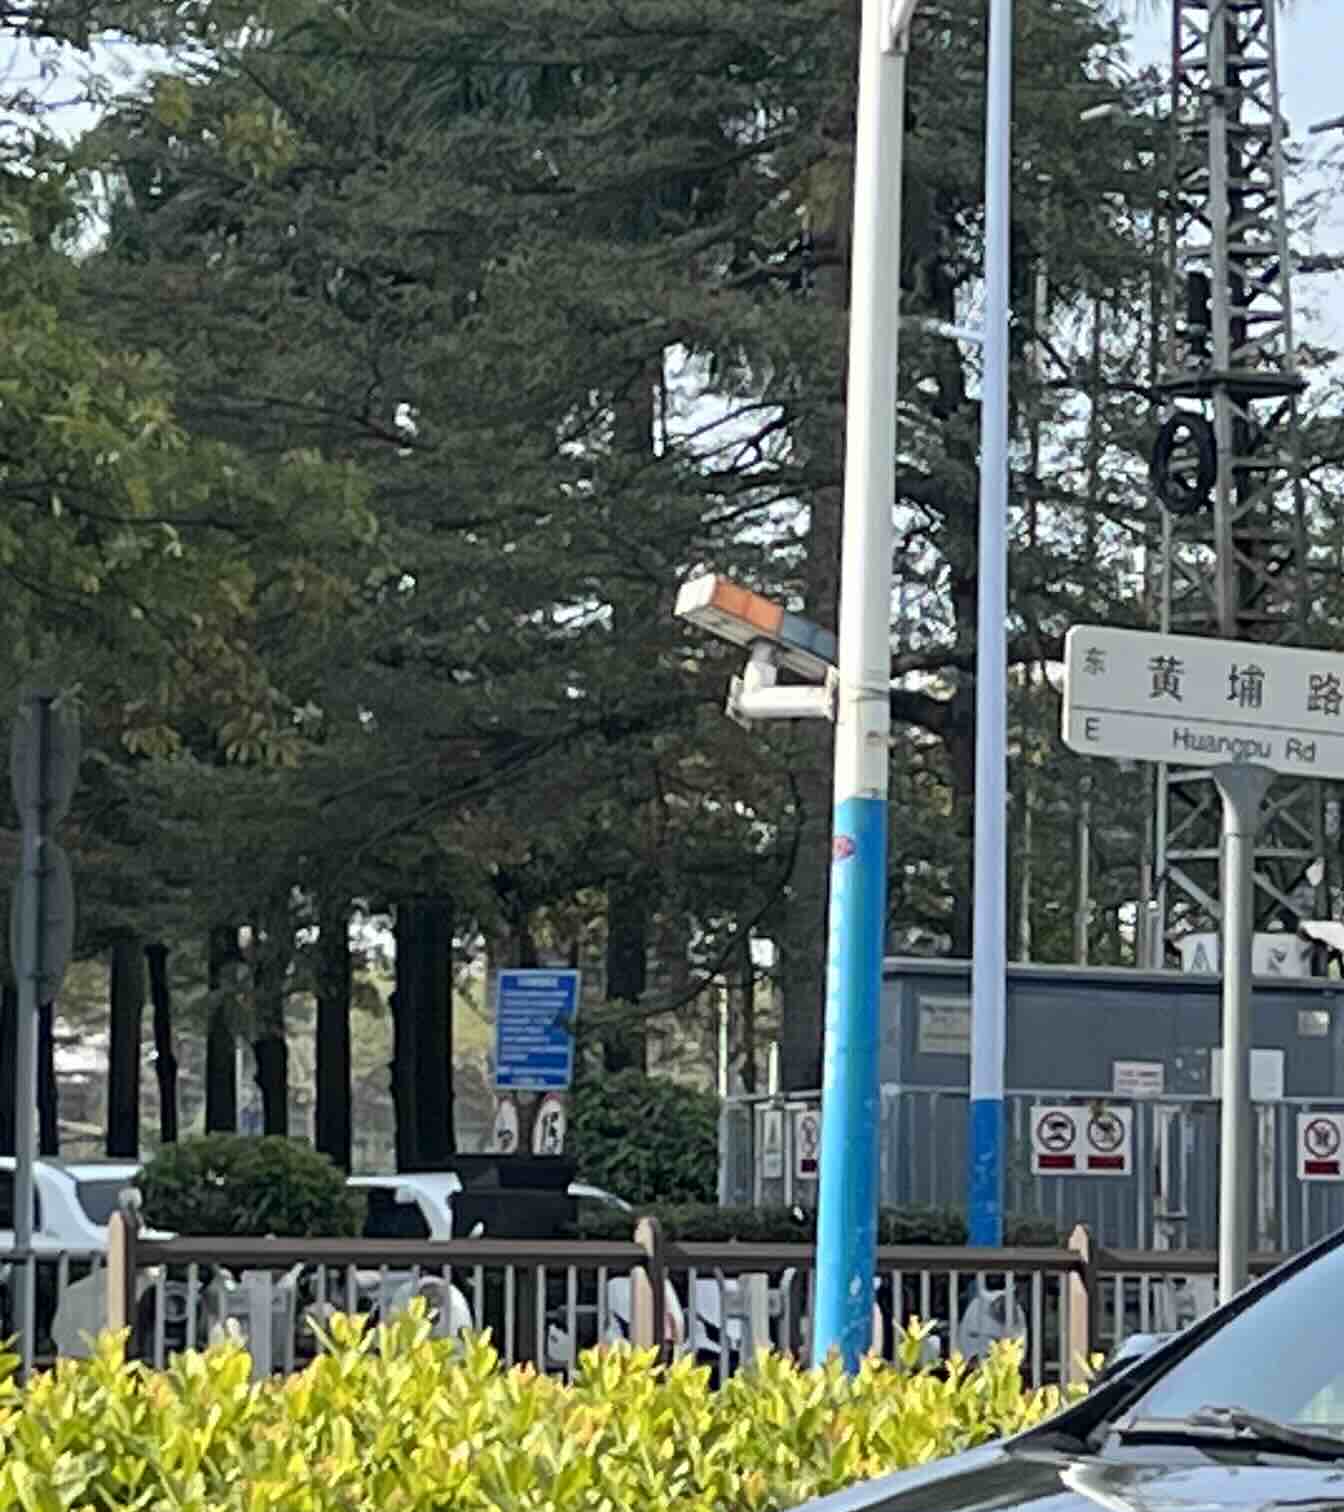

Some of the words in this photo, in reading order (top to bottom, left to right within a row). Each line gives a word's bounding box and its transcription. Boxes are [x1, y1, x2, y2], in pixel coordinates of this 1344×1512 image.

[1083, 647, 1106, 676] 东
[1085, 718, 1100, 742] E
[1172, 727, 1273, 760] Huangpu
[1284, 737, 1317, 763] Rd
